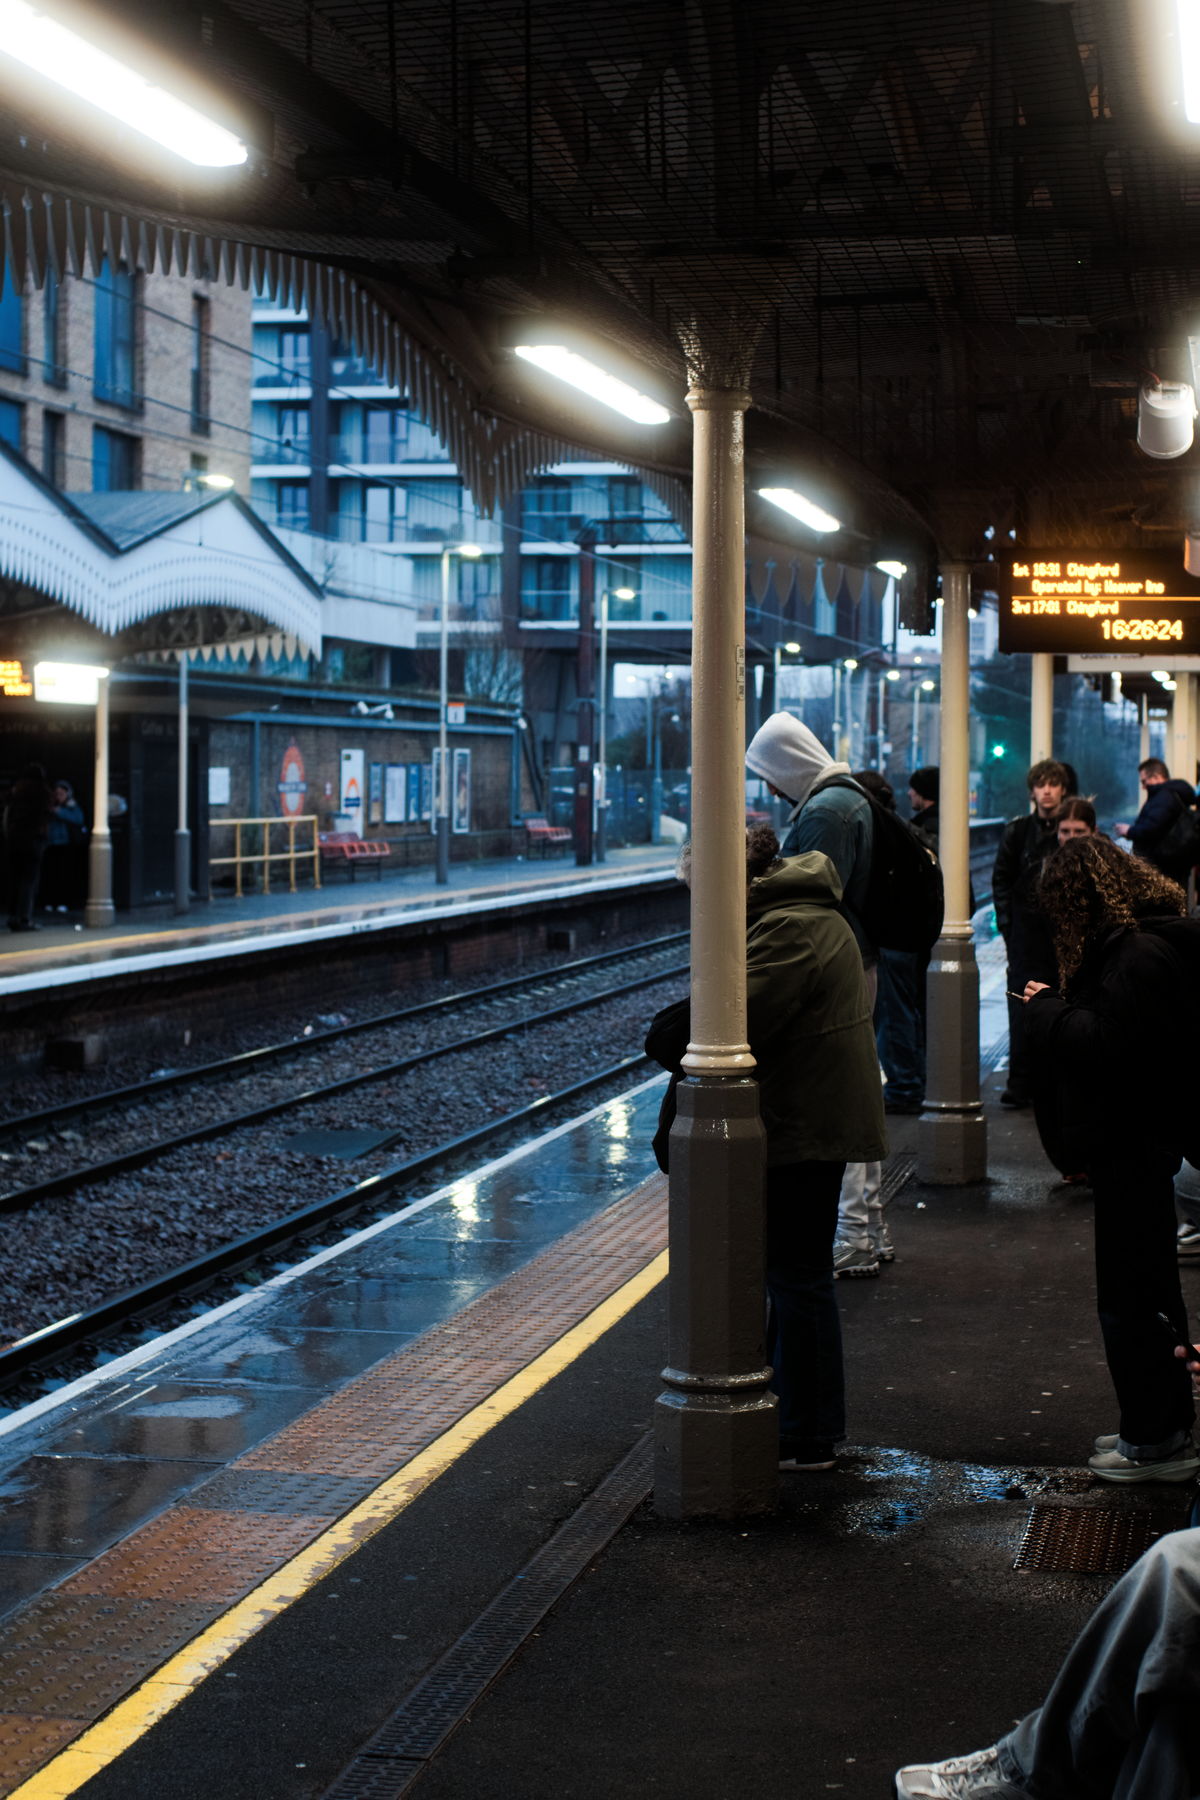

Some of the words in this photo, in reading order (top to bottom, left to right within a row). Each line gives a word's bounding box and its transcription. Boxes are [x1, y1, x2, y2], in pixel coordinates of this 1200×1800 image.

[1012, 562, 1030, 577] 1st
[1032, 562, 1061, 577] 16:31
[1066, 562, 1120, 580] Chingford
[1031, 579, 1082, 595] Operated
[1011, 600, 1031, 614] 3rd
[1066, 600, 1119, 618] Chingford
[1101, 619, 1183, 640] 16:26:24
